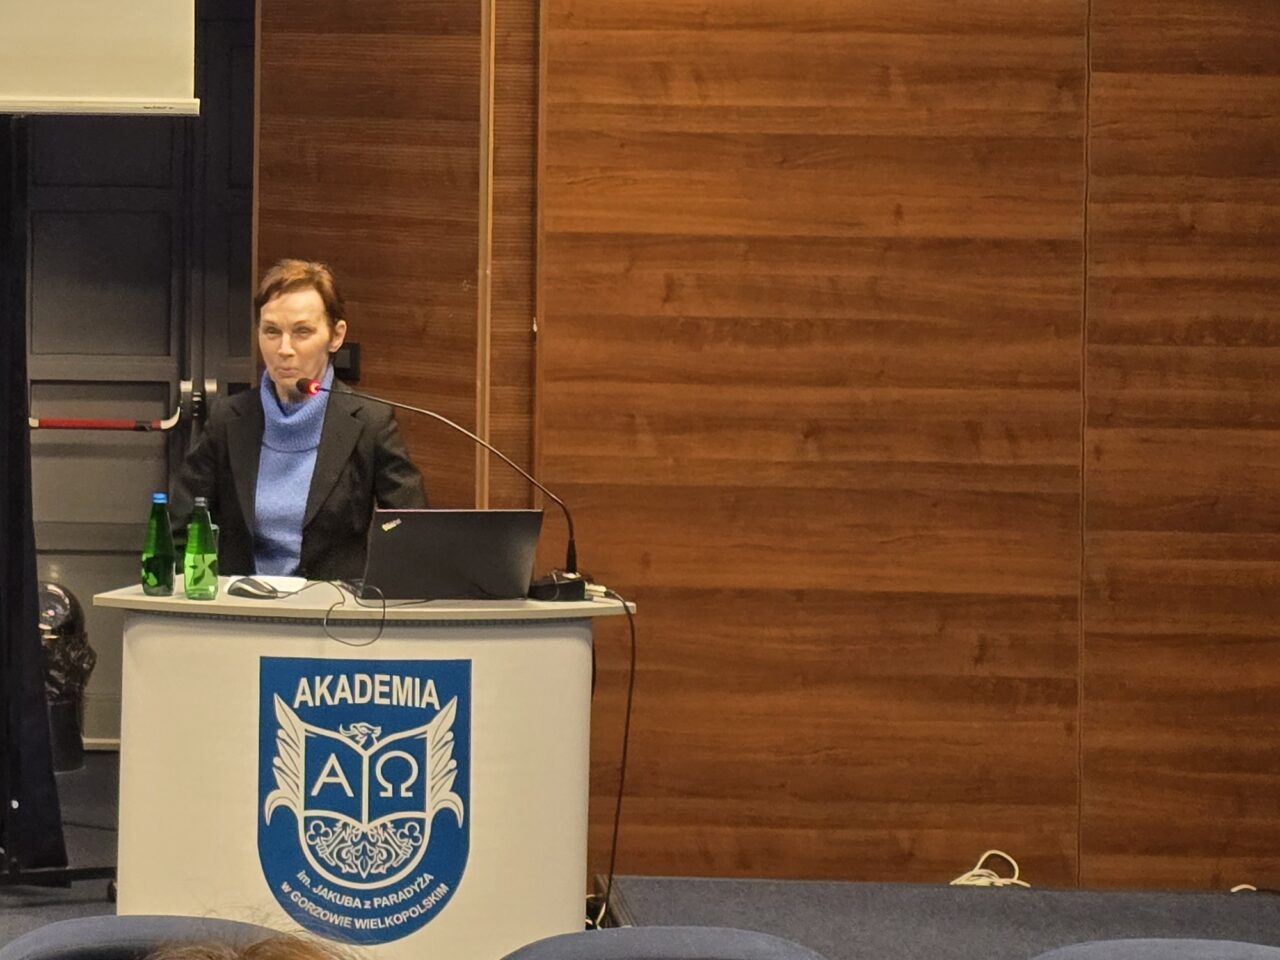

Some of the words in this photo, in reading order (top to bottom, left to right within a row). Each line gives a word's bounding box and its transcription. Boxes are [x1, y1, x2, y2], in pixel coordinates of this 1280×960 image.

[293, 673, 441, 711] AKADEMIA
[280, 881, 293, 893] w
[290, 891, 353, 928] GORZOWIE
[354, 883, 450, 930] WIELKOPOLSKIM
[295, 870, 312, 889] im.
[312, 885, 362, 909] JAKUBA
[363, 900, 372, 909] z
[373, 872, 434, 909] PARADYŻA
